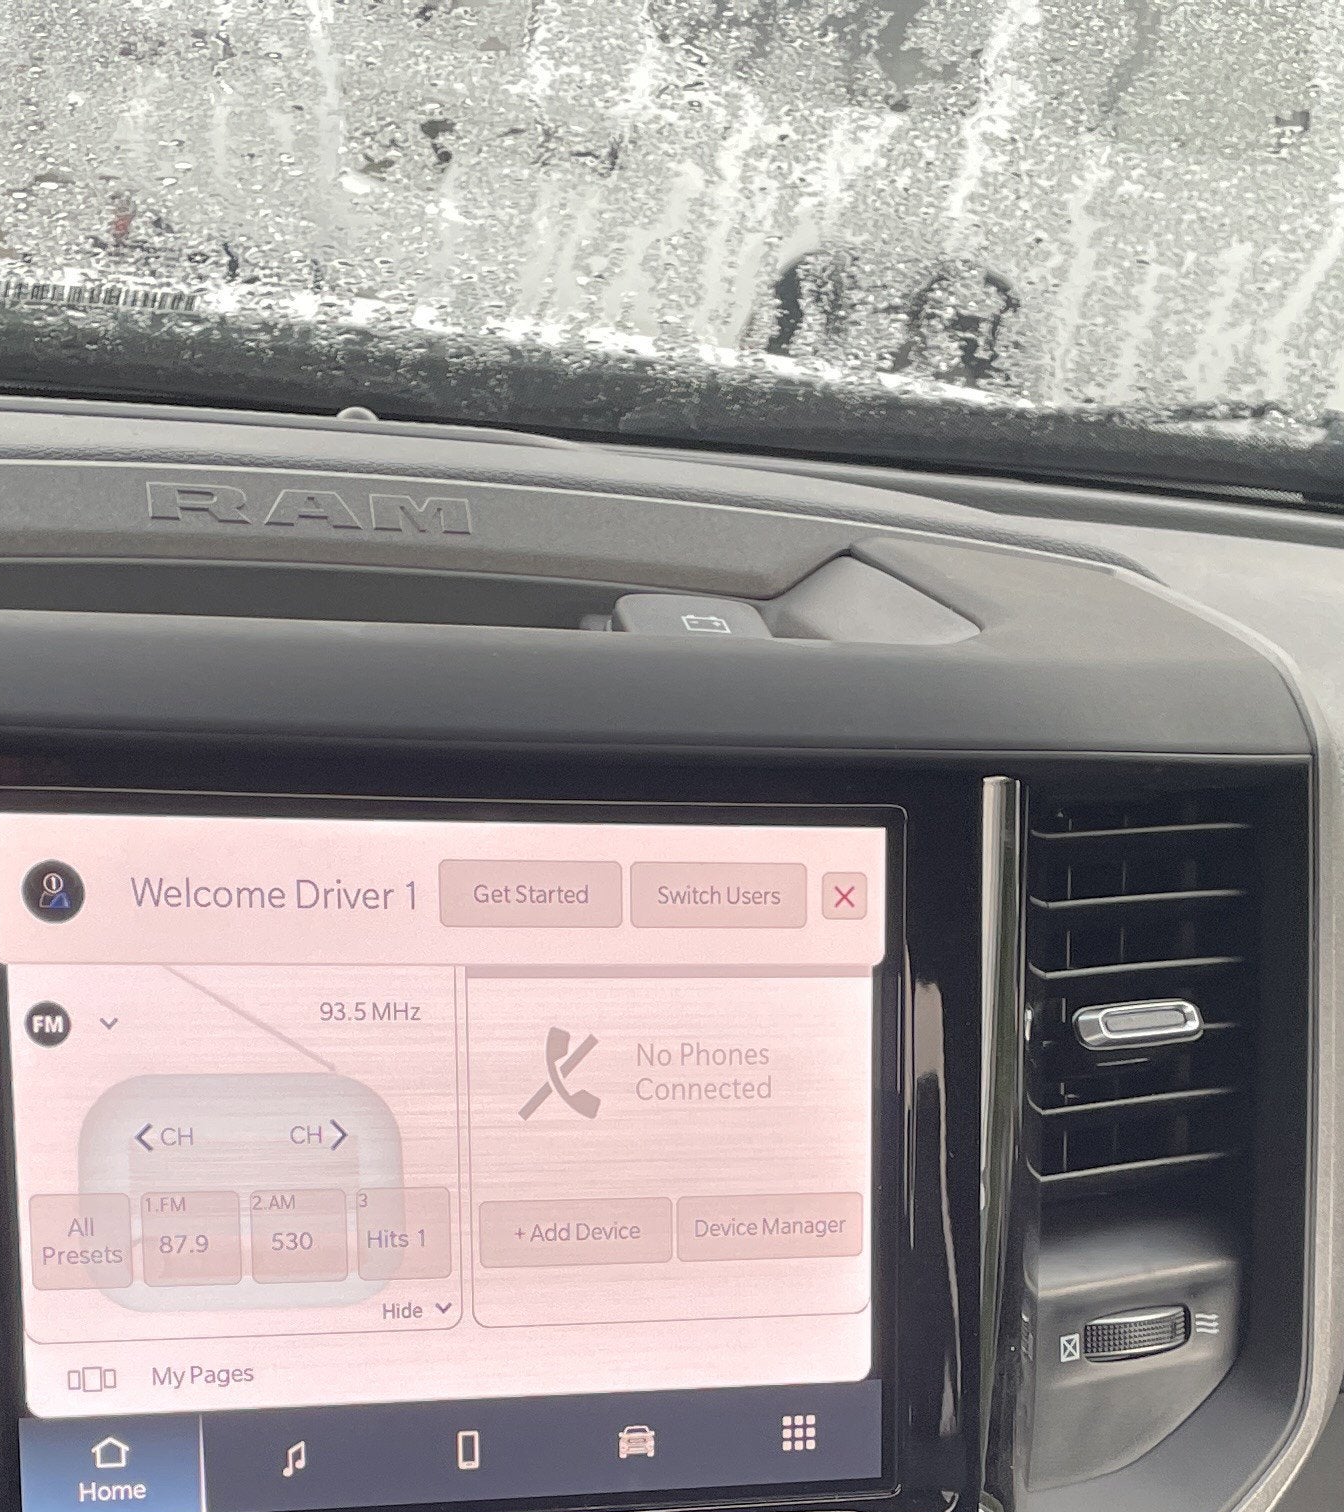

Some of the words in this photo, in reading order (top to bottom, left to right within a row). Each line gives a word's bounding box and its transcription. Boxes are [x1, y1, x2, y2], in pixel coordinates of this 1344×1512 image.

[145, 481, 473, 536] RAM
[130, 876, 286, 910] Welcome
[296, 878, 395, 911] Driver
[405, 881, 417, 911] 1
[472, 884, 512, 905] Get
[515, 883, 590, 905] Started
[657, 885, 722, 906] Switch
[726, 886, 782, 907] Users
[319, 1001, 367, 1023] 93.5
[371, 1001, 422, 1022] MHz
[31, 1014, 65, 1035] FM
[636, 1042, 672, 1068] No
[680, 1041, 771, 1067] Phones
[635, 1074, 773, 1101] Connected
[160, 1126, 195, 1147] CH
[289, 1125, 323, 1146] CH
[145, 1196, 187, 1213] 1.FM
[251, 1194, 296, 1211] 2.AM
[67, 1217, 95, 1238] All
[530, 1221, 571, 1243] Add
[576, 1221, 642, 1242] Device
[694, 1217, 758, 1239] Device
[762, 1215, 847, 1239] Manager
[158, 1233, 210, 1254] 87.9
[271, 1231, 314, 1252] 530
[367, 1229, 409, 1249] Hits
[417, 1228, 426, 1248] 1
[42, 1245, 124, 1267] Presets
[382, 1302, 423, 1320] Hide
[152, 1366, 186, 1390] My
[190, 1364, 255, 1388] Pages
[78, 1480, 147, 1503] Home
